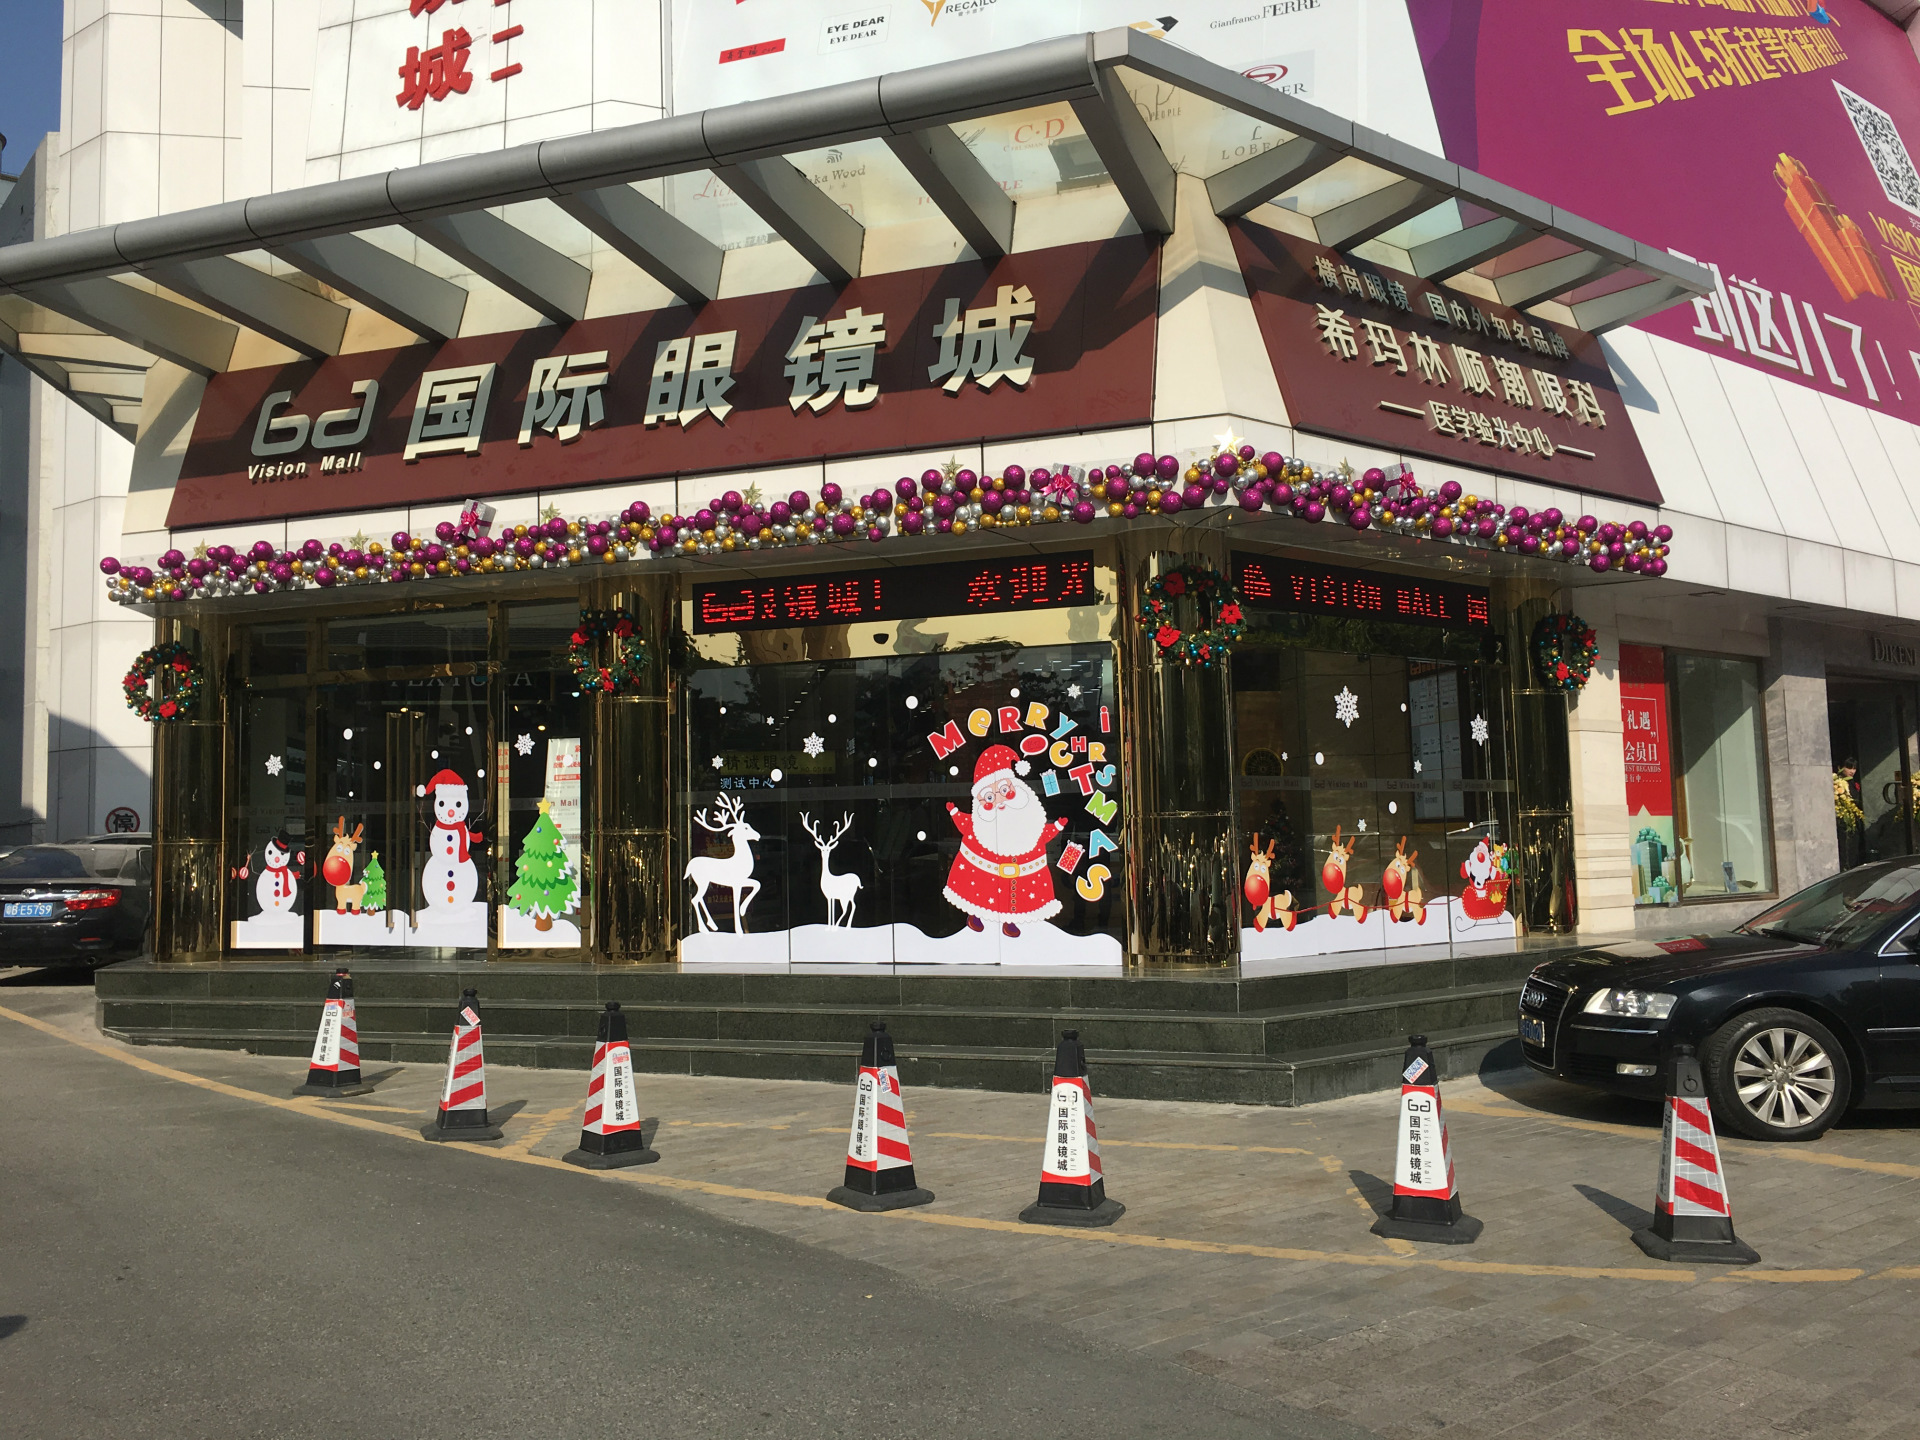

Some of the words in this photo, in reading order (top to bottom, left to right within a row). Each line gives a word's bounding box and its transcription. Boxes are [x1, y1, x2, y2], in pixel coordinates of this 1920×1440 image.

[827, 23, 849, 34] EYE
[852, 16, 885, 29] DEAR
[830, 35, 848, 45] EYE
[851, 29, 877, 40] DEAR
[1210, 14, 1260, 29] Gianfranco
[832, 165, 866, 182] Wood
[1315, 256, 1413, 312] 横岗眼镜
[1425, 292, 1570, 359] 国内外知名品牌
[403, 285, 1036, 461] 国际眼镜城
[1315, 303, 1607, 427] 希玛林顺潮眼科
[247, 460, 307, 480] Vision
[319, 453, 362, 471] Mall
[1290, 575, 1382, 611] VISION
[1624, 741, 1658, 762] 会员日
[720, 776, 775, 790] 测试中心
[614, 1066, 624, 1121] 国际眼镜城
[1057, 1107, 1068, 1171] 国际眼镜城
[1409, 1115, 1422, 1184] 国际眼镜城
